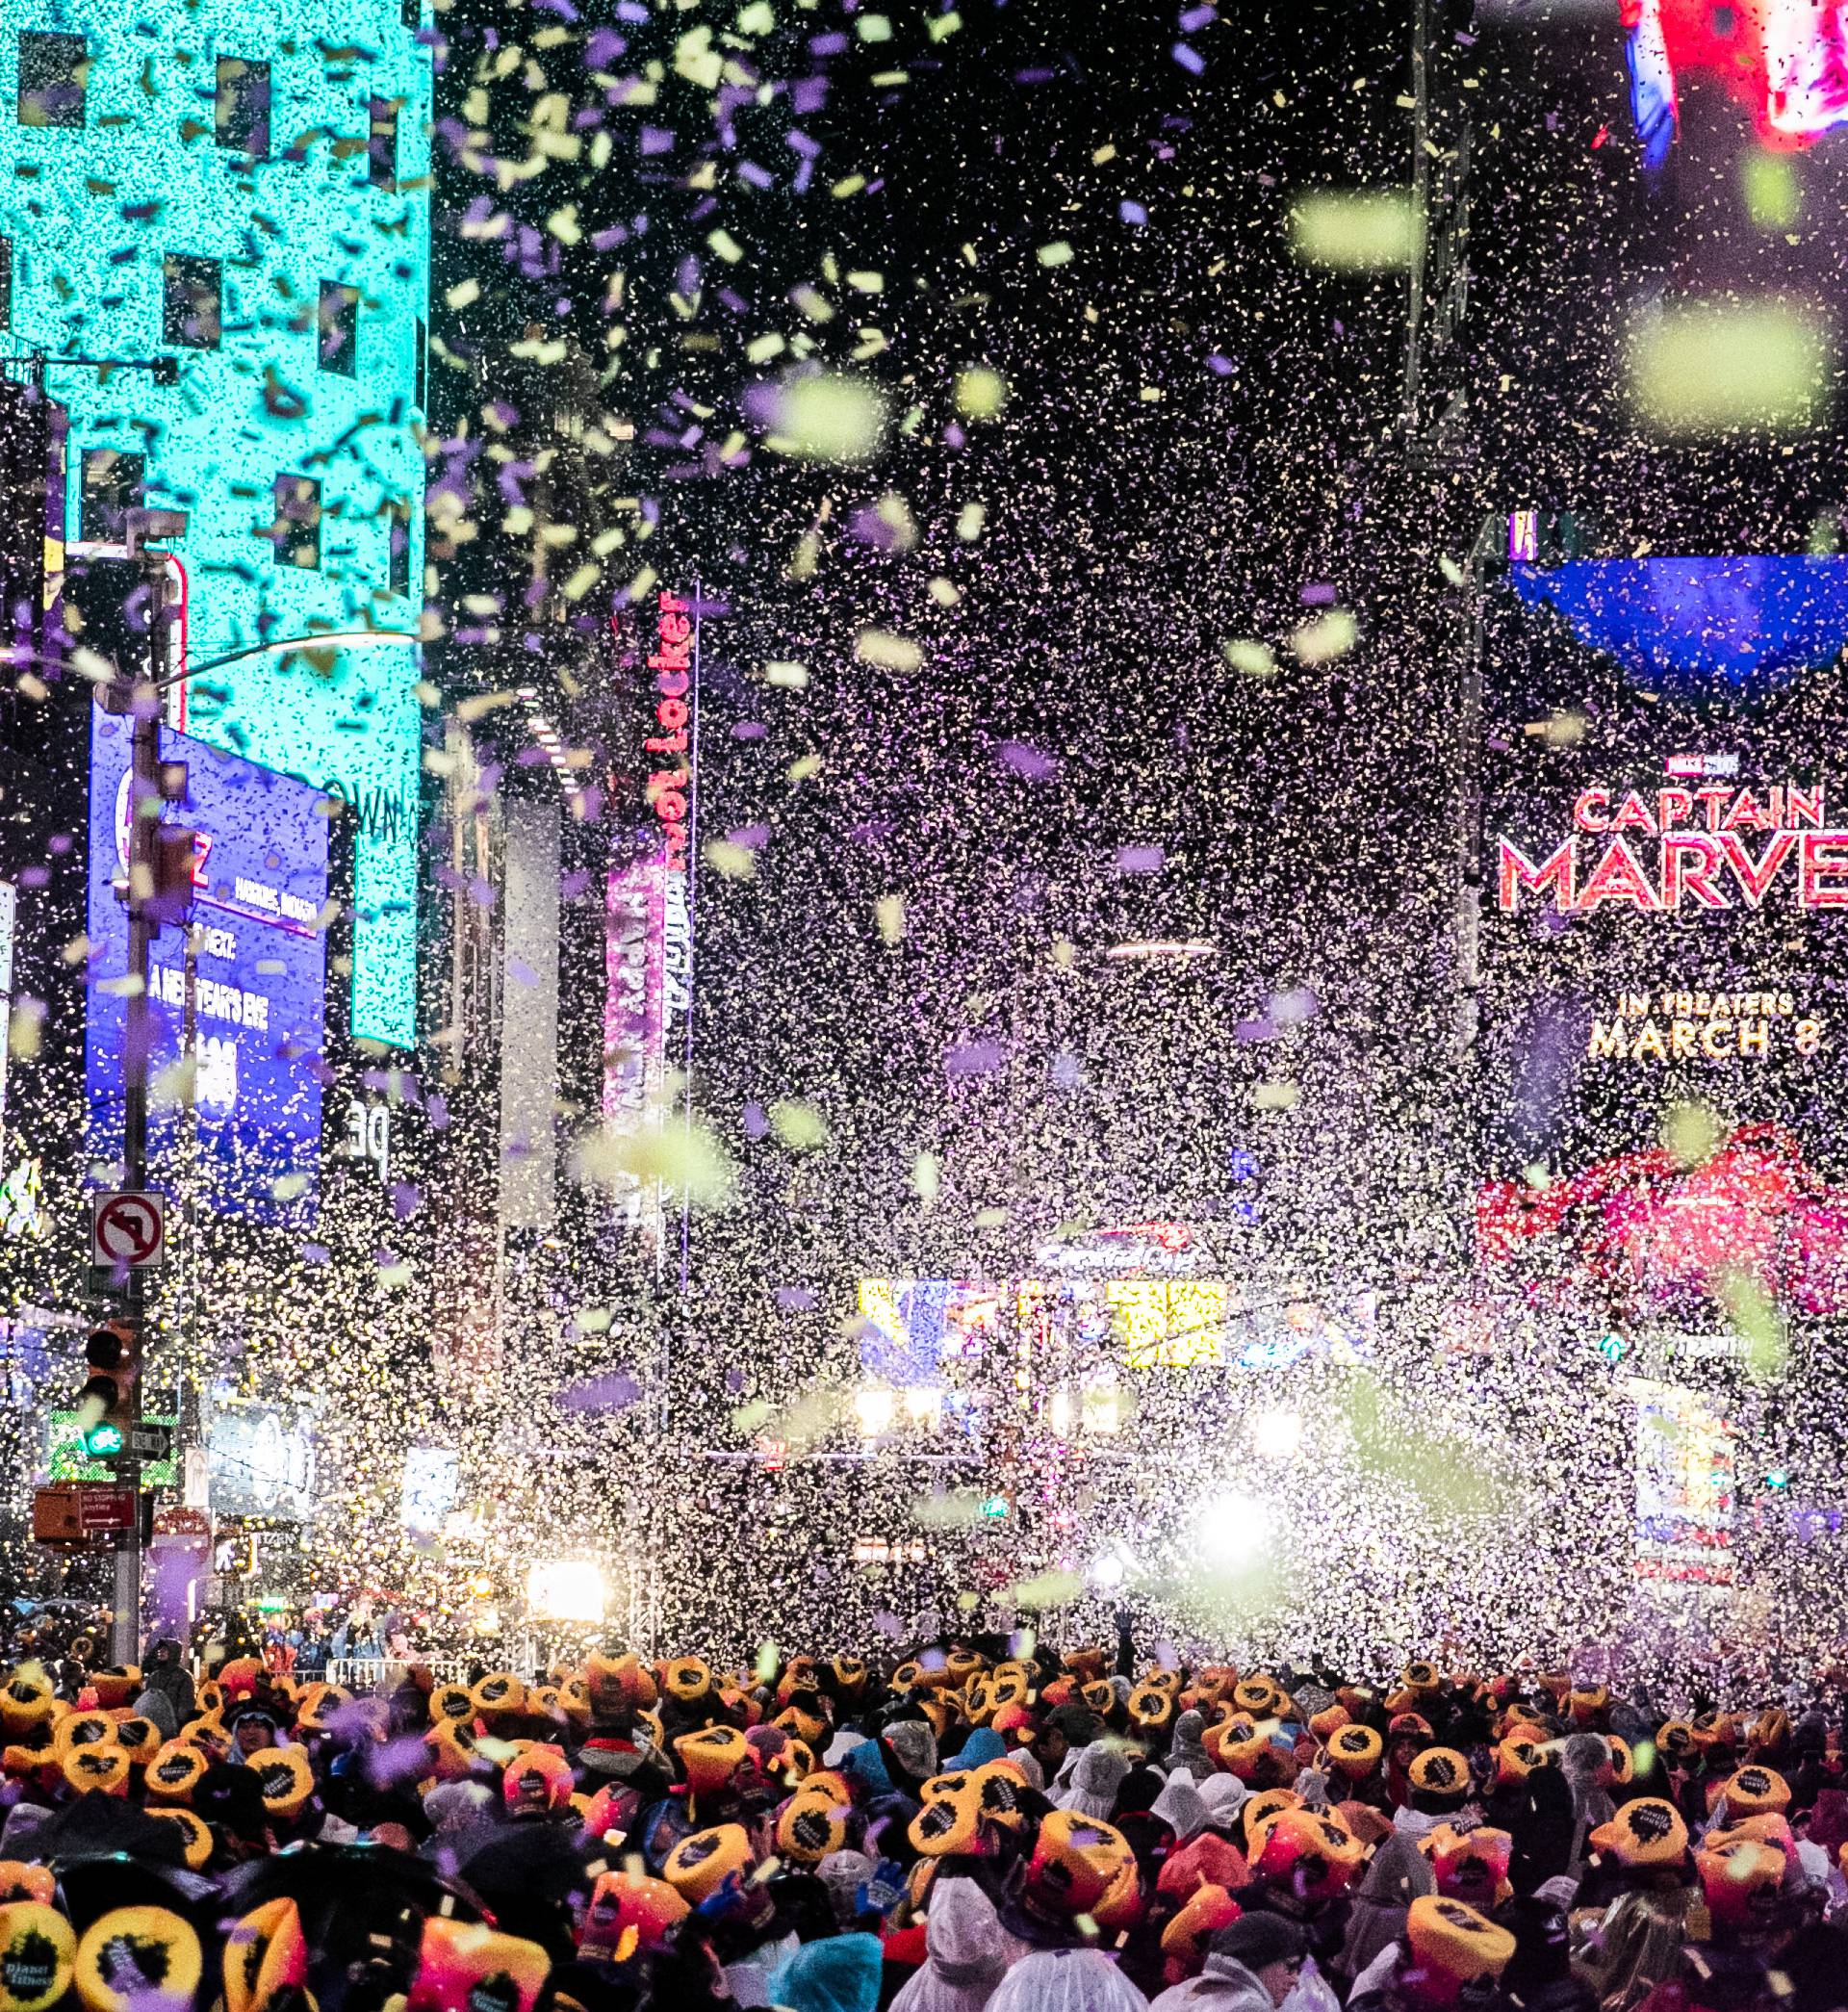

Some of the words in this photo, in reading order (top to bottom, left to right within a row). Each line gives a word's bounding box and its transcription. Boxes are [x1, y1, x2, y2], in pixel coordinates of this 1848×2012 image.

[645, 590, 691, 753] Locker
[1573, 785, 1826, 833] CAPTAIN
[1499, 829, 1848, 912] MARVE
[243, 991, 270, 1030] EVE
[1618, 992, 1650, 1017] IN
[1662, 992, 1794, 1017] THEATERS
[1587, 1017, 1769, 1060] MARCH
[1794, 1019, 1822, 1057] 8
